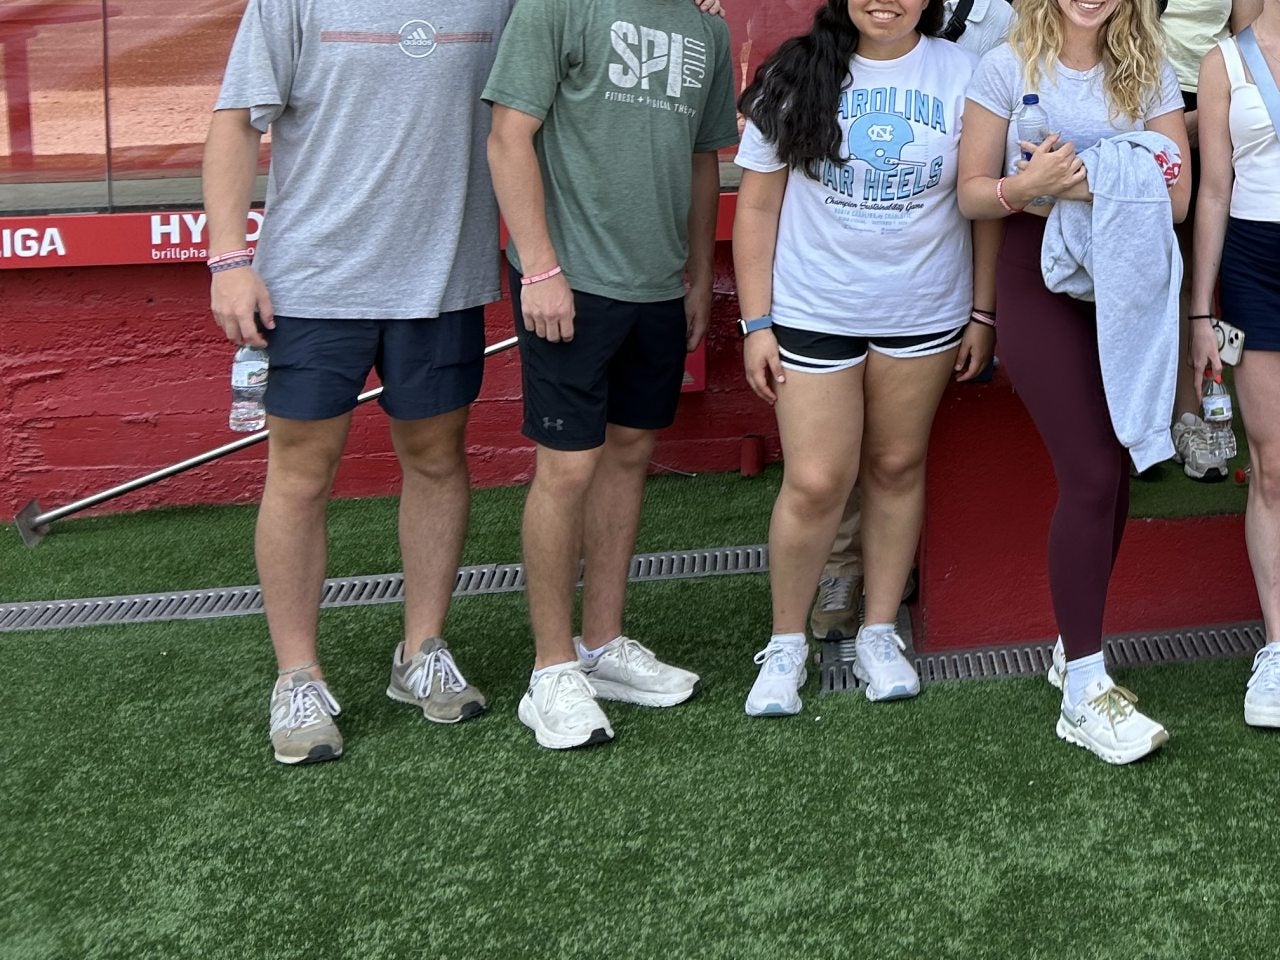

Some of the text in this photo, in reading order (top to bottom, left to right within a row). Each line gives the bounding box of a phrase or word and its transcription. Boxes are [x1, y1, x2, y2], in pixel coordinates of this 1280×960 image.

[608, 20, 683, 97] SPI
[683, 37, 706, 88] UTICA
[837, 87, 946, 134] AROLINA
[813, 155, 943, 202] AR HEELS
[0, 227, 67, 258] IGA
[151, 211, 265, 245] HYO
